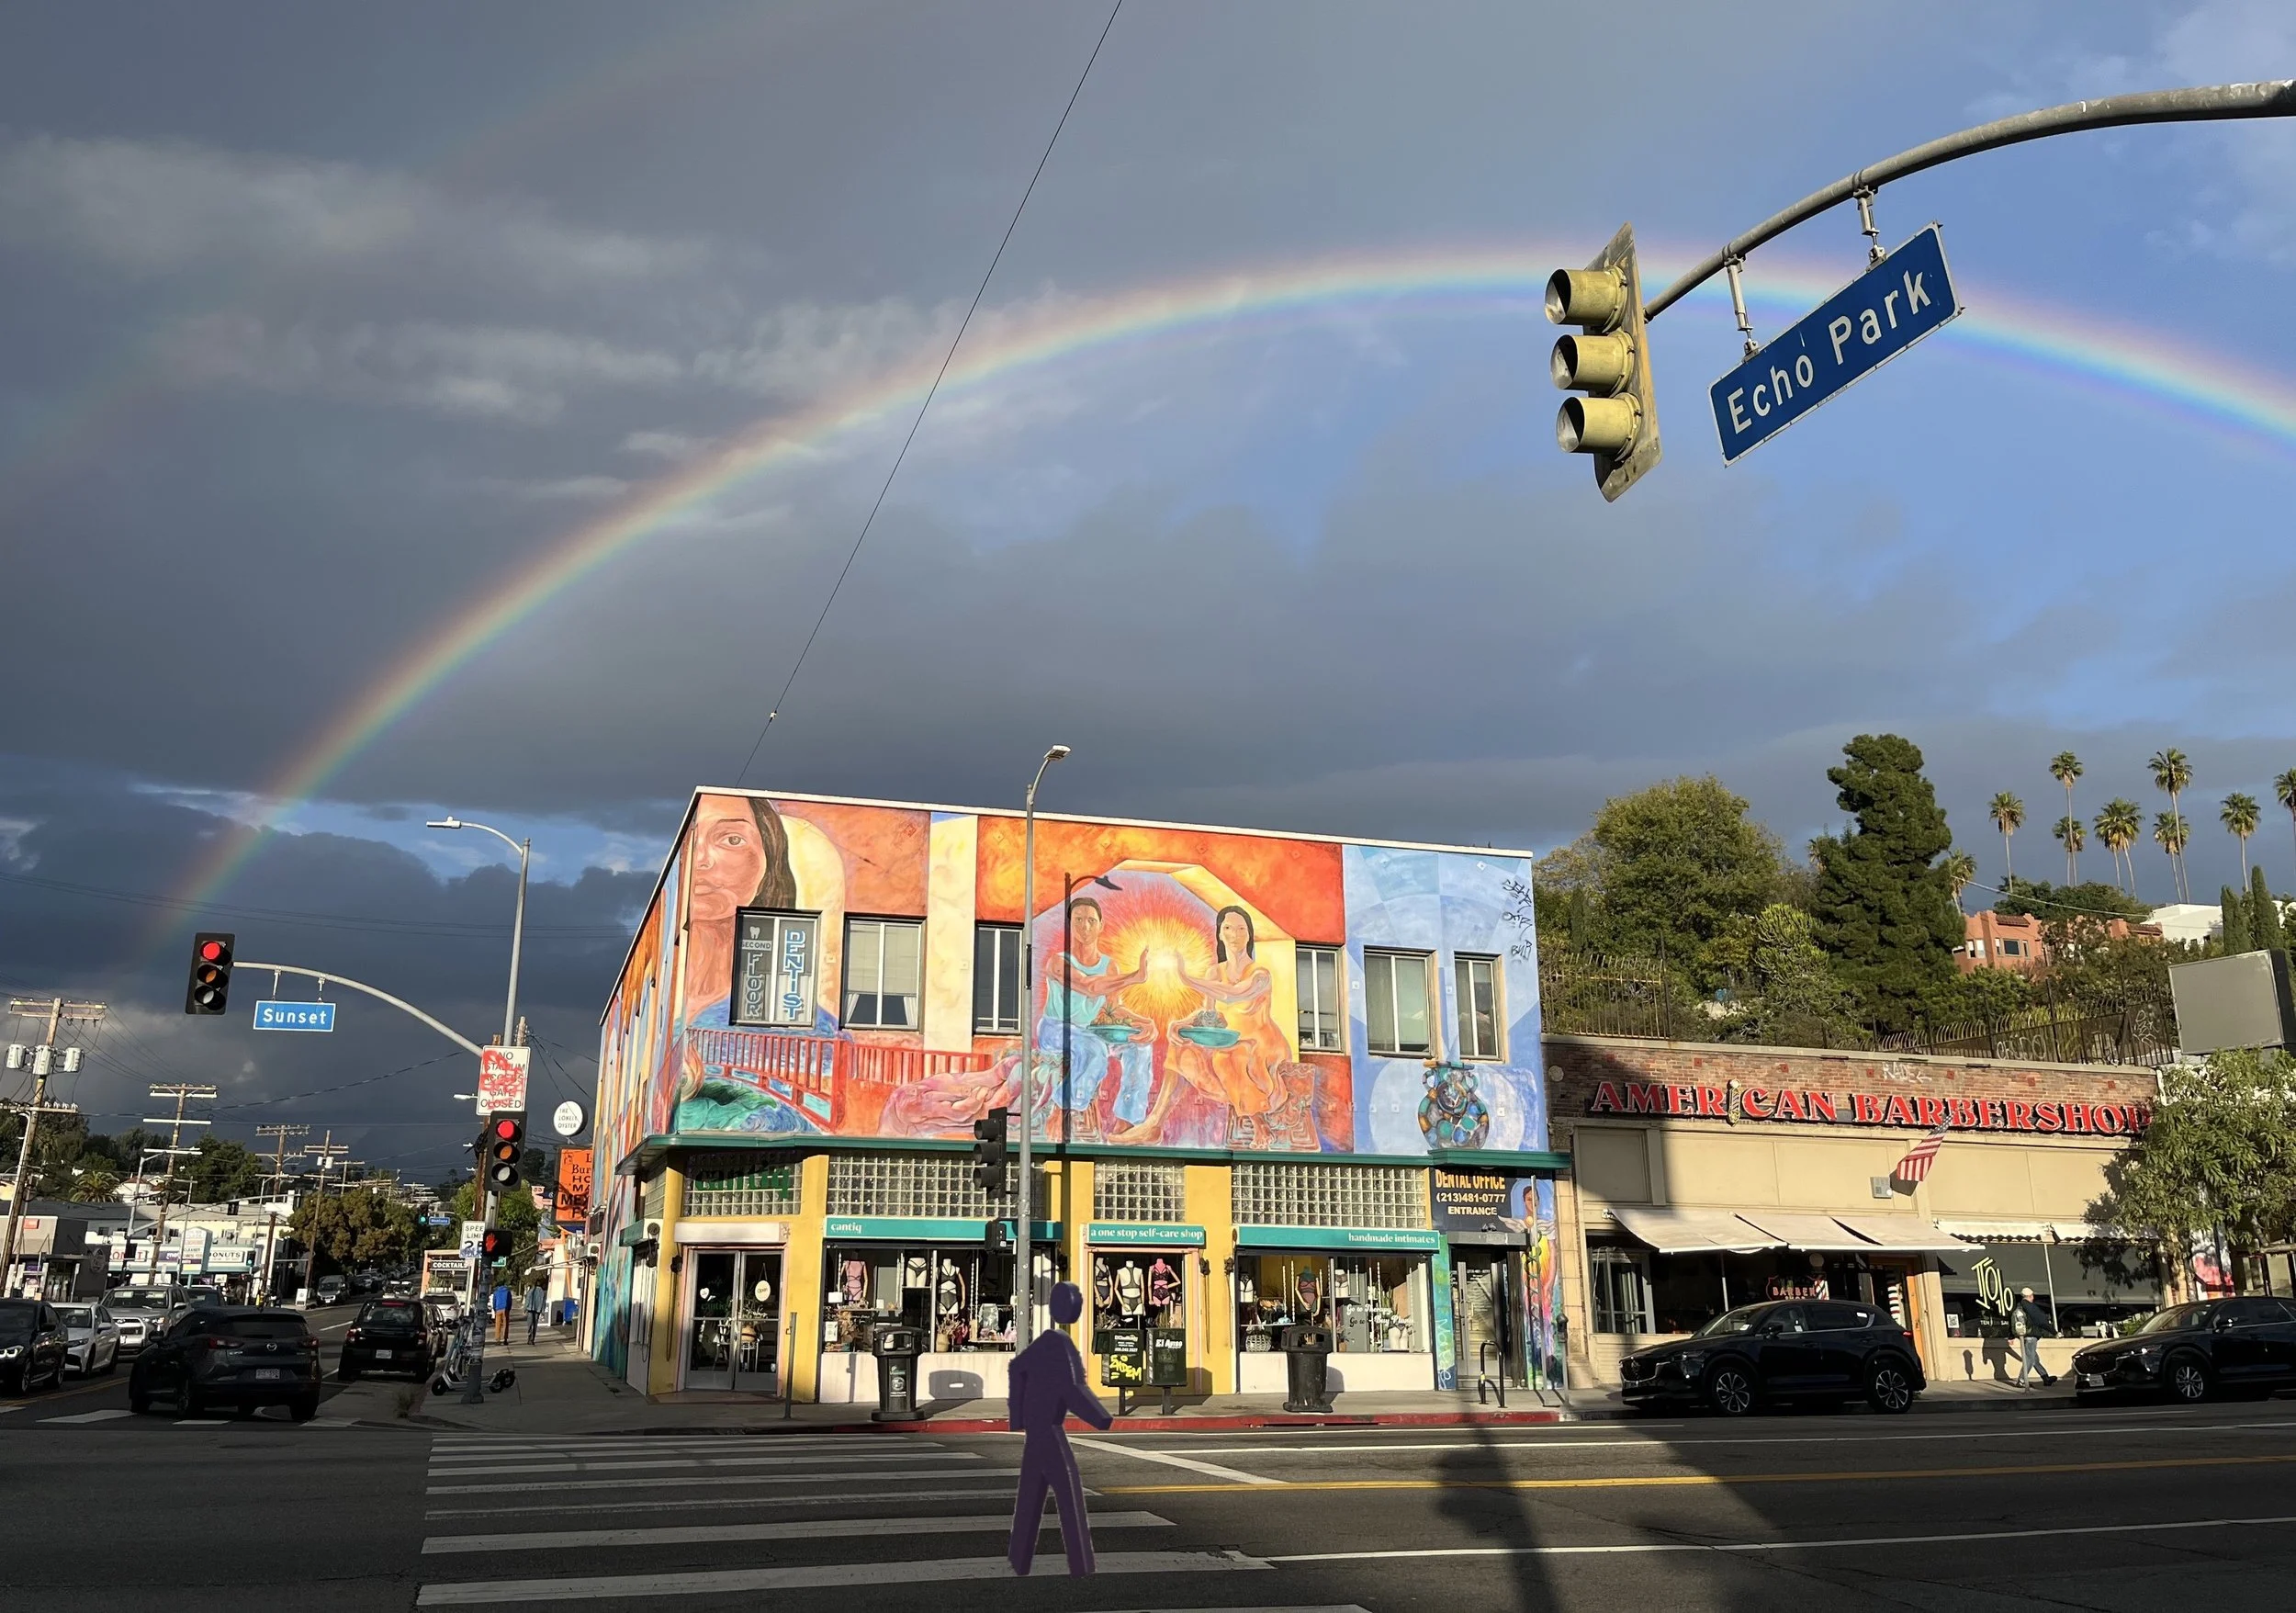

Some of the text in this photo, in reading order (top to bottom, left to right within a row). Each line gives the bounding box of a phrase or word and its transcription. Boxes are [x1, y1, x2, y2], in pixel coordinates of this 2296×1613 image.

[1728, 270, 1931, 434] Echo Park
[782, 929, 806, 1021] DENTIST
[745, 952, 763, 1017] FLOOR
[263, 1008, 327, 1025] Sunset
[487, 1062, 525, 1071] STAIUM
[480, 1099, 522, 1109] CLOSED
[1591, 1080, 2153, 1135] AMERICAN BARBERSHOP
[1435, 1168, 1505, 1190] DENTAL OFFICE
[1436, 1192, 1506, 1203] (213)481-0777
[1447, 1206, 1498, 1215] ENTRANCE
[830, 1223, 862, 1235] cantiq
[1117, 1228, 1138, 1239] stop
[1139, 1228, 1179, 1238] self-care
[1180, 1229, 1203, 1241] shop
[1348, 1233, 1435, 1244] handmade intimates
